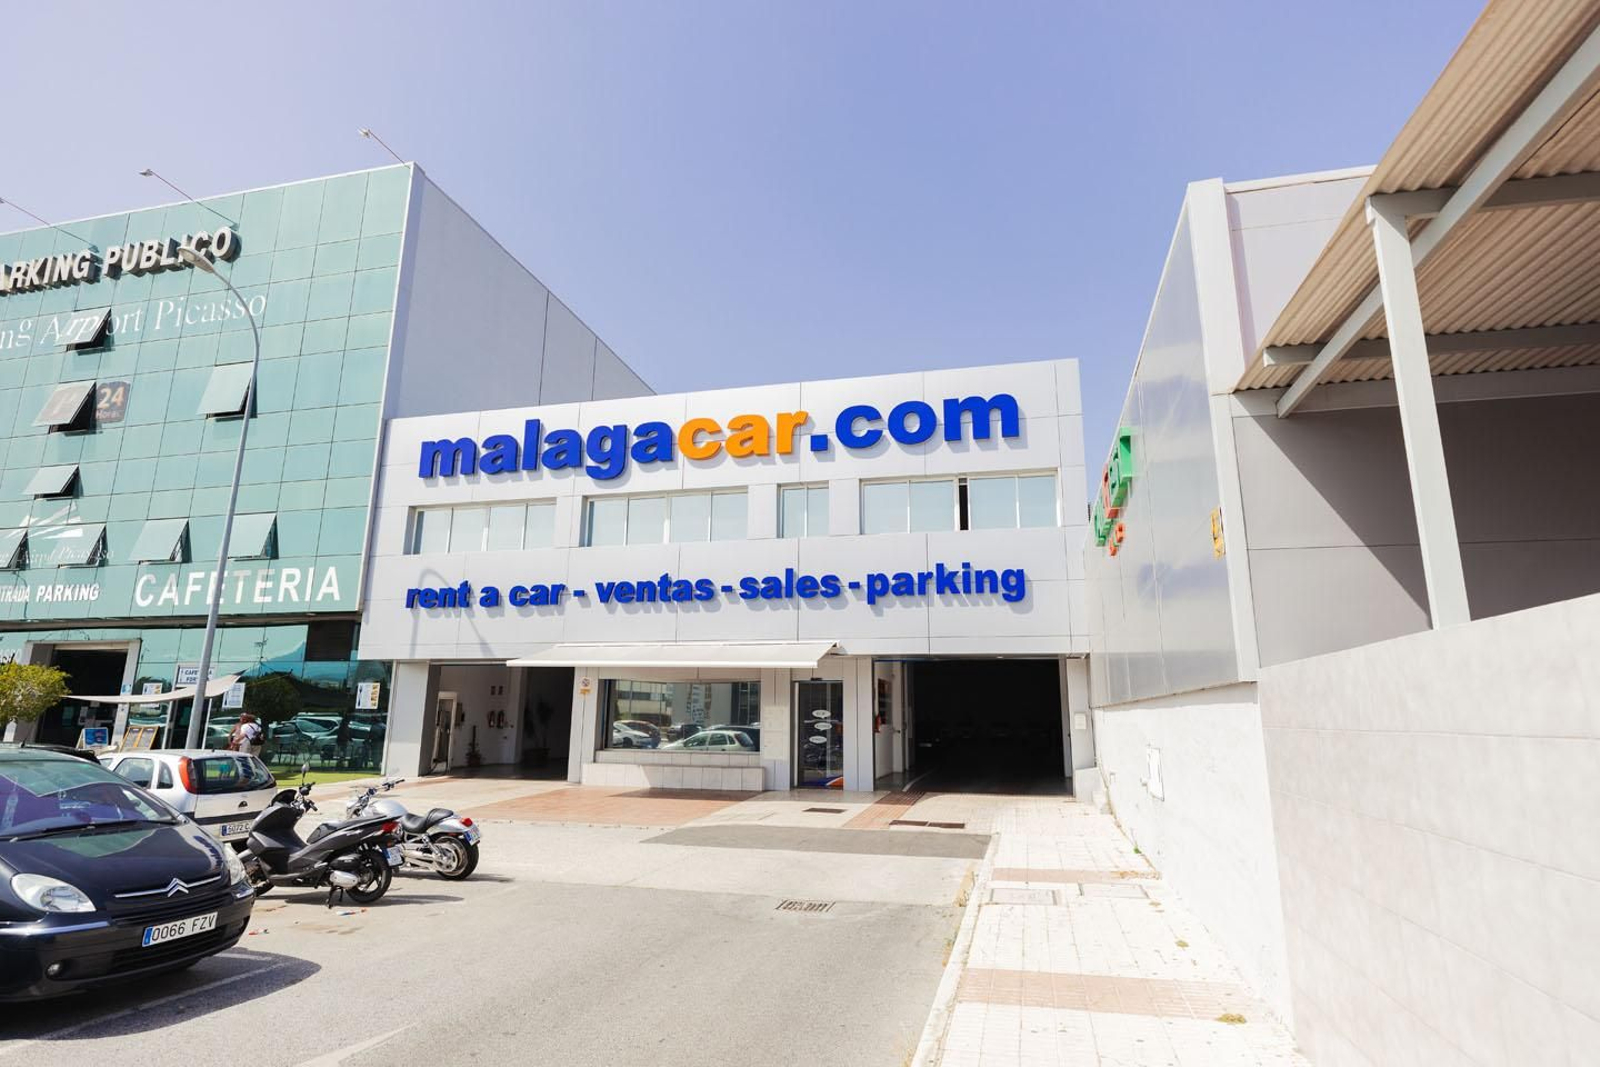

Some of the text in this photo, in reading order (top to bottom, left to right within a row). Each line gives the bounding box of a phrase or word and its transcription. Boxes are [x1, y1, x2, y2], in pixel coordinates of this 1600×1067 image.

[101, 226, 234, 275] PUBLICO
[40, 305, 142, 345] Arport
[155, 294, 267, 330] Picasso
[97, 386, 126, 410] 24
[418, 392, 1020, 480] malagacar.com
[36, 582, 101, 602] PARKING
[134, 566, 341, 608] CAFETERIA
[405, 579, 471, 609] rent
[479, 585, 500, 608] a
[508, 582, 566, 607] car
[594, 572, 715, 604] ventas
[738, 567, 842, 601] sales
[866, 561, 1026, 605] parking
[151, 915, 216, 942] 0066 FZV
